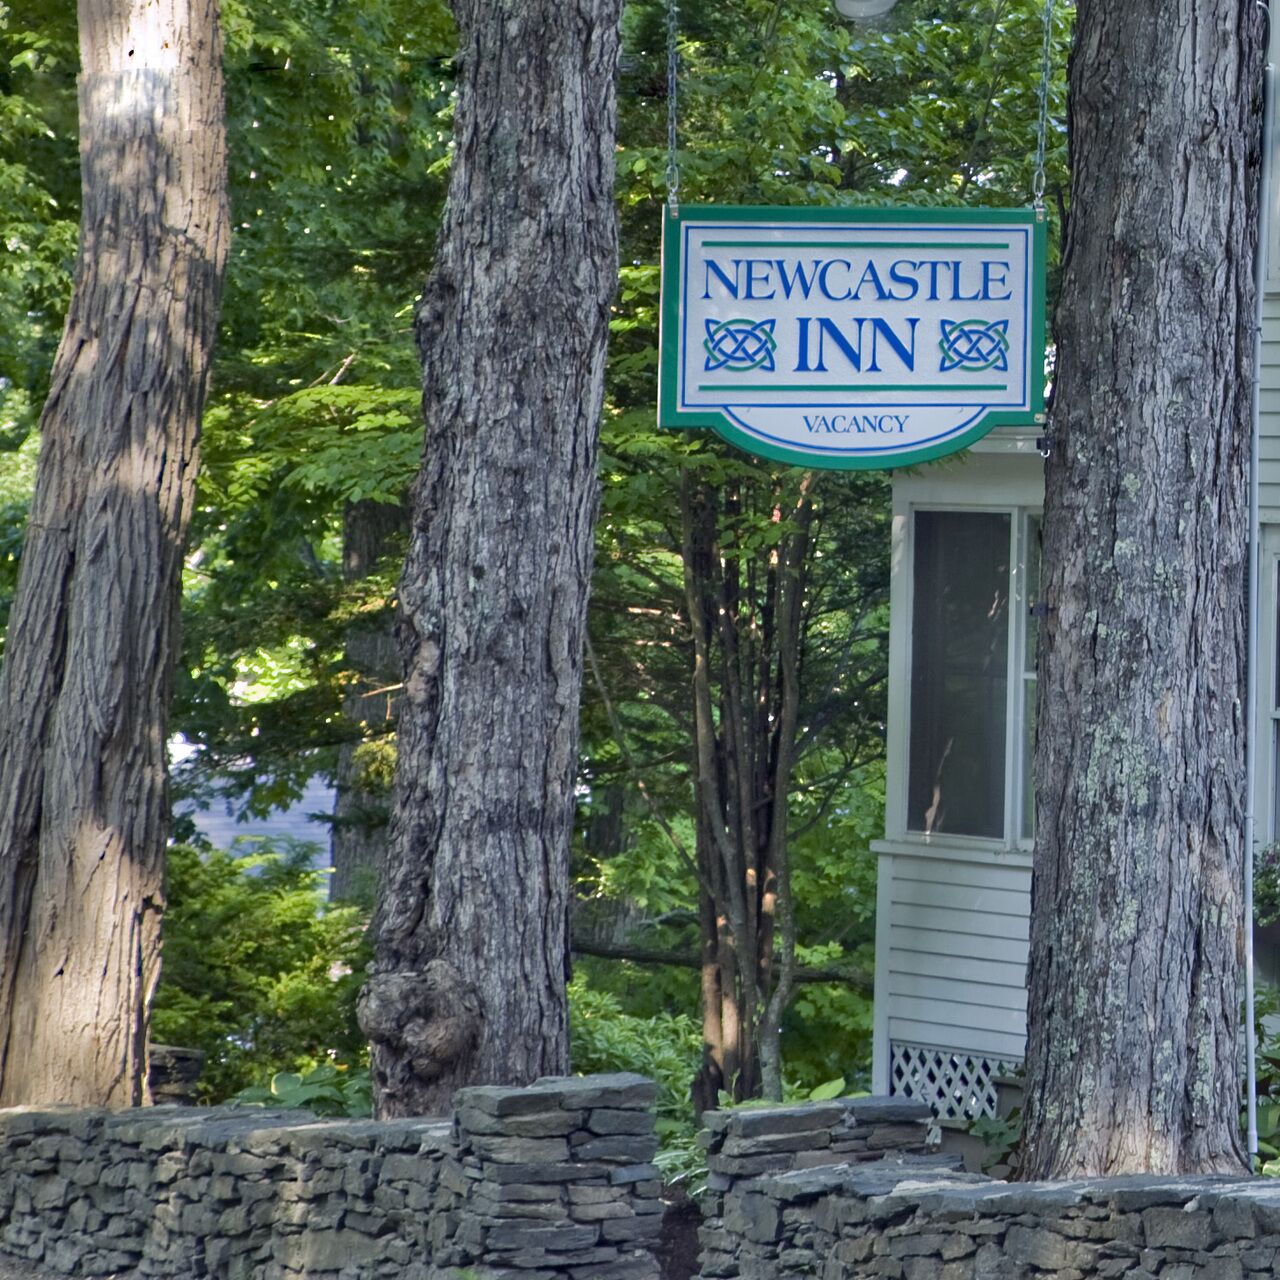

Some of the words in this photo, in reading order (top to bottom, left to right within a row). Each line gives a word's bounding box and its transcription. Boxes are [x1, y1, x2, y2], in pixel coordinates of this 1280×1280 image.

[701, 258, 1013, 302] NEWCASTLE
[792, 316, 921, 374] INN
[802, 414, 911, 435] VACANCY
